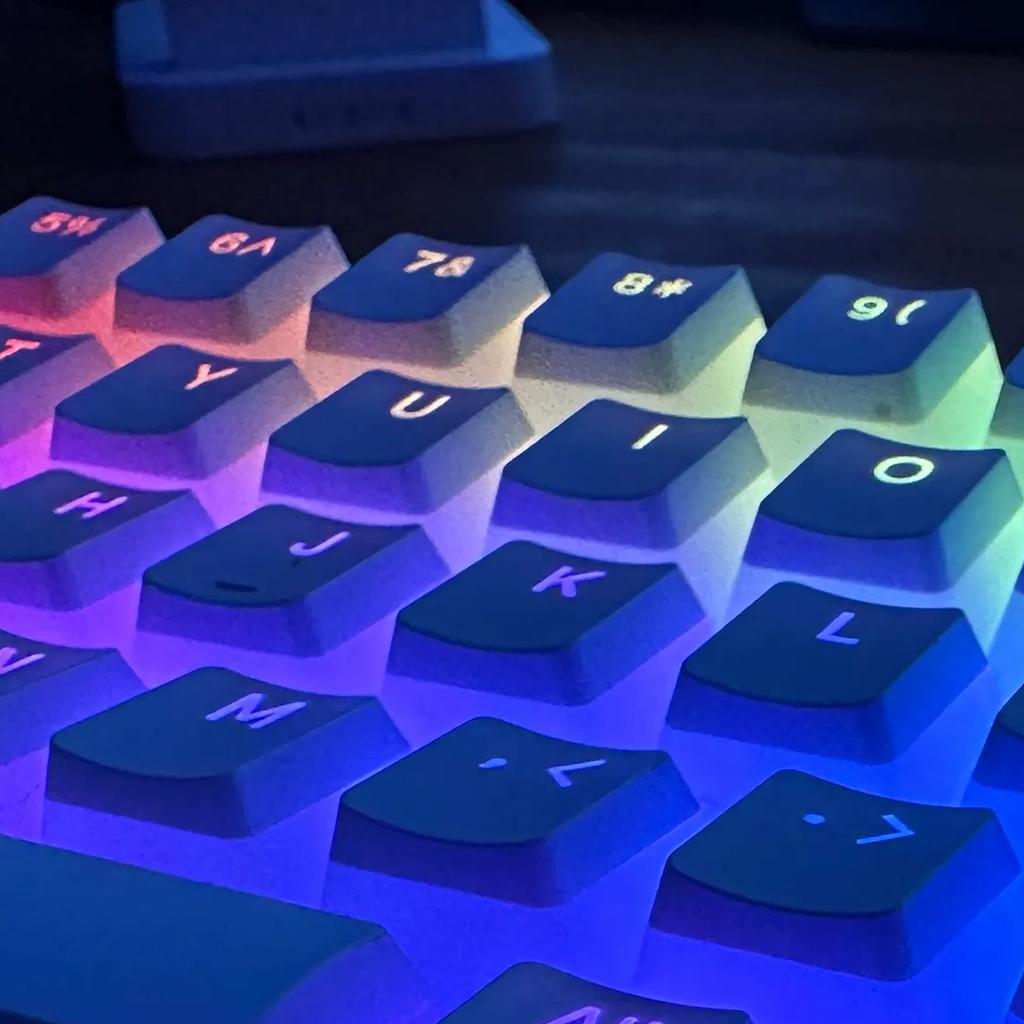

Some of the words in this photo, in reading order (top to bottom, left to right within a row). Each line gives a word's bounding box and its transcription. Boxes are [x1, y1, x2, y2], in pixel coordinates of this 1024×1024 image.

[186, 364, 237, 389] Y
[391, 392, 450, 418] U
[874, 456, 934, 484] O
[55, 492, 128, 518] H
[290, 532, 349, 556] J
[532, 566, 605, 597] K
[816, 612, 859, 644] L
[206, 692, 306, 728] M
